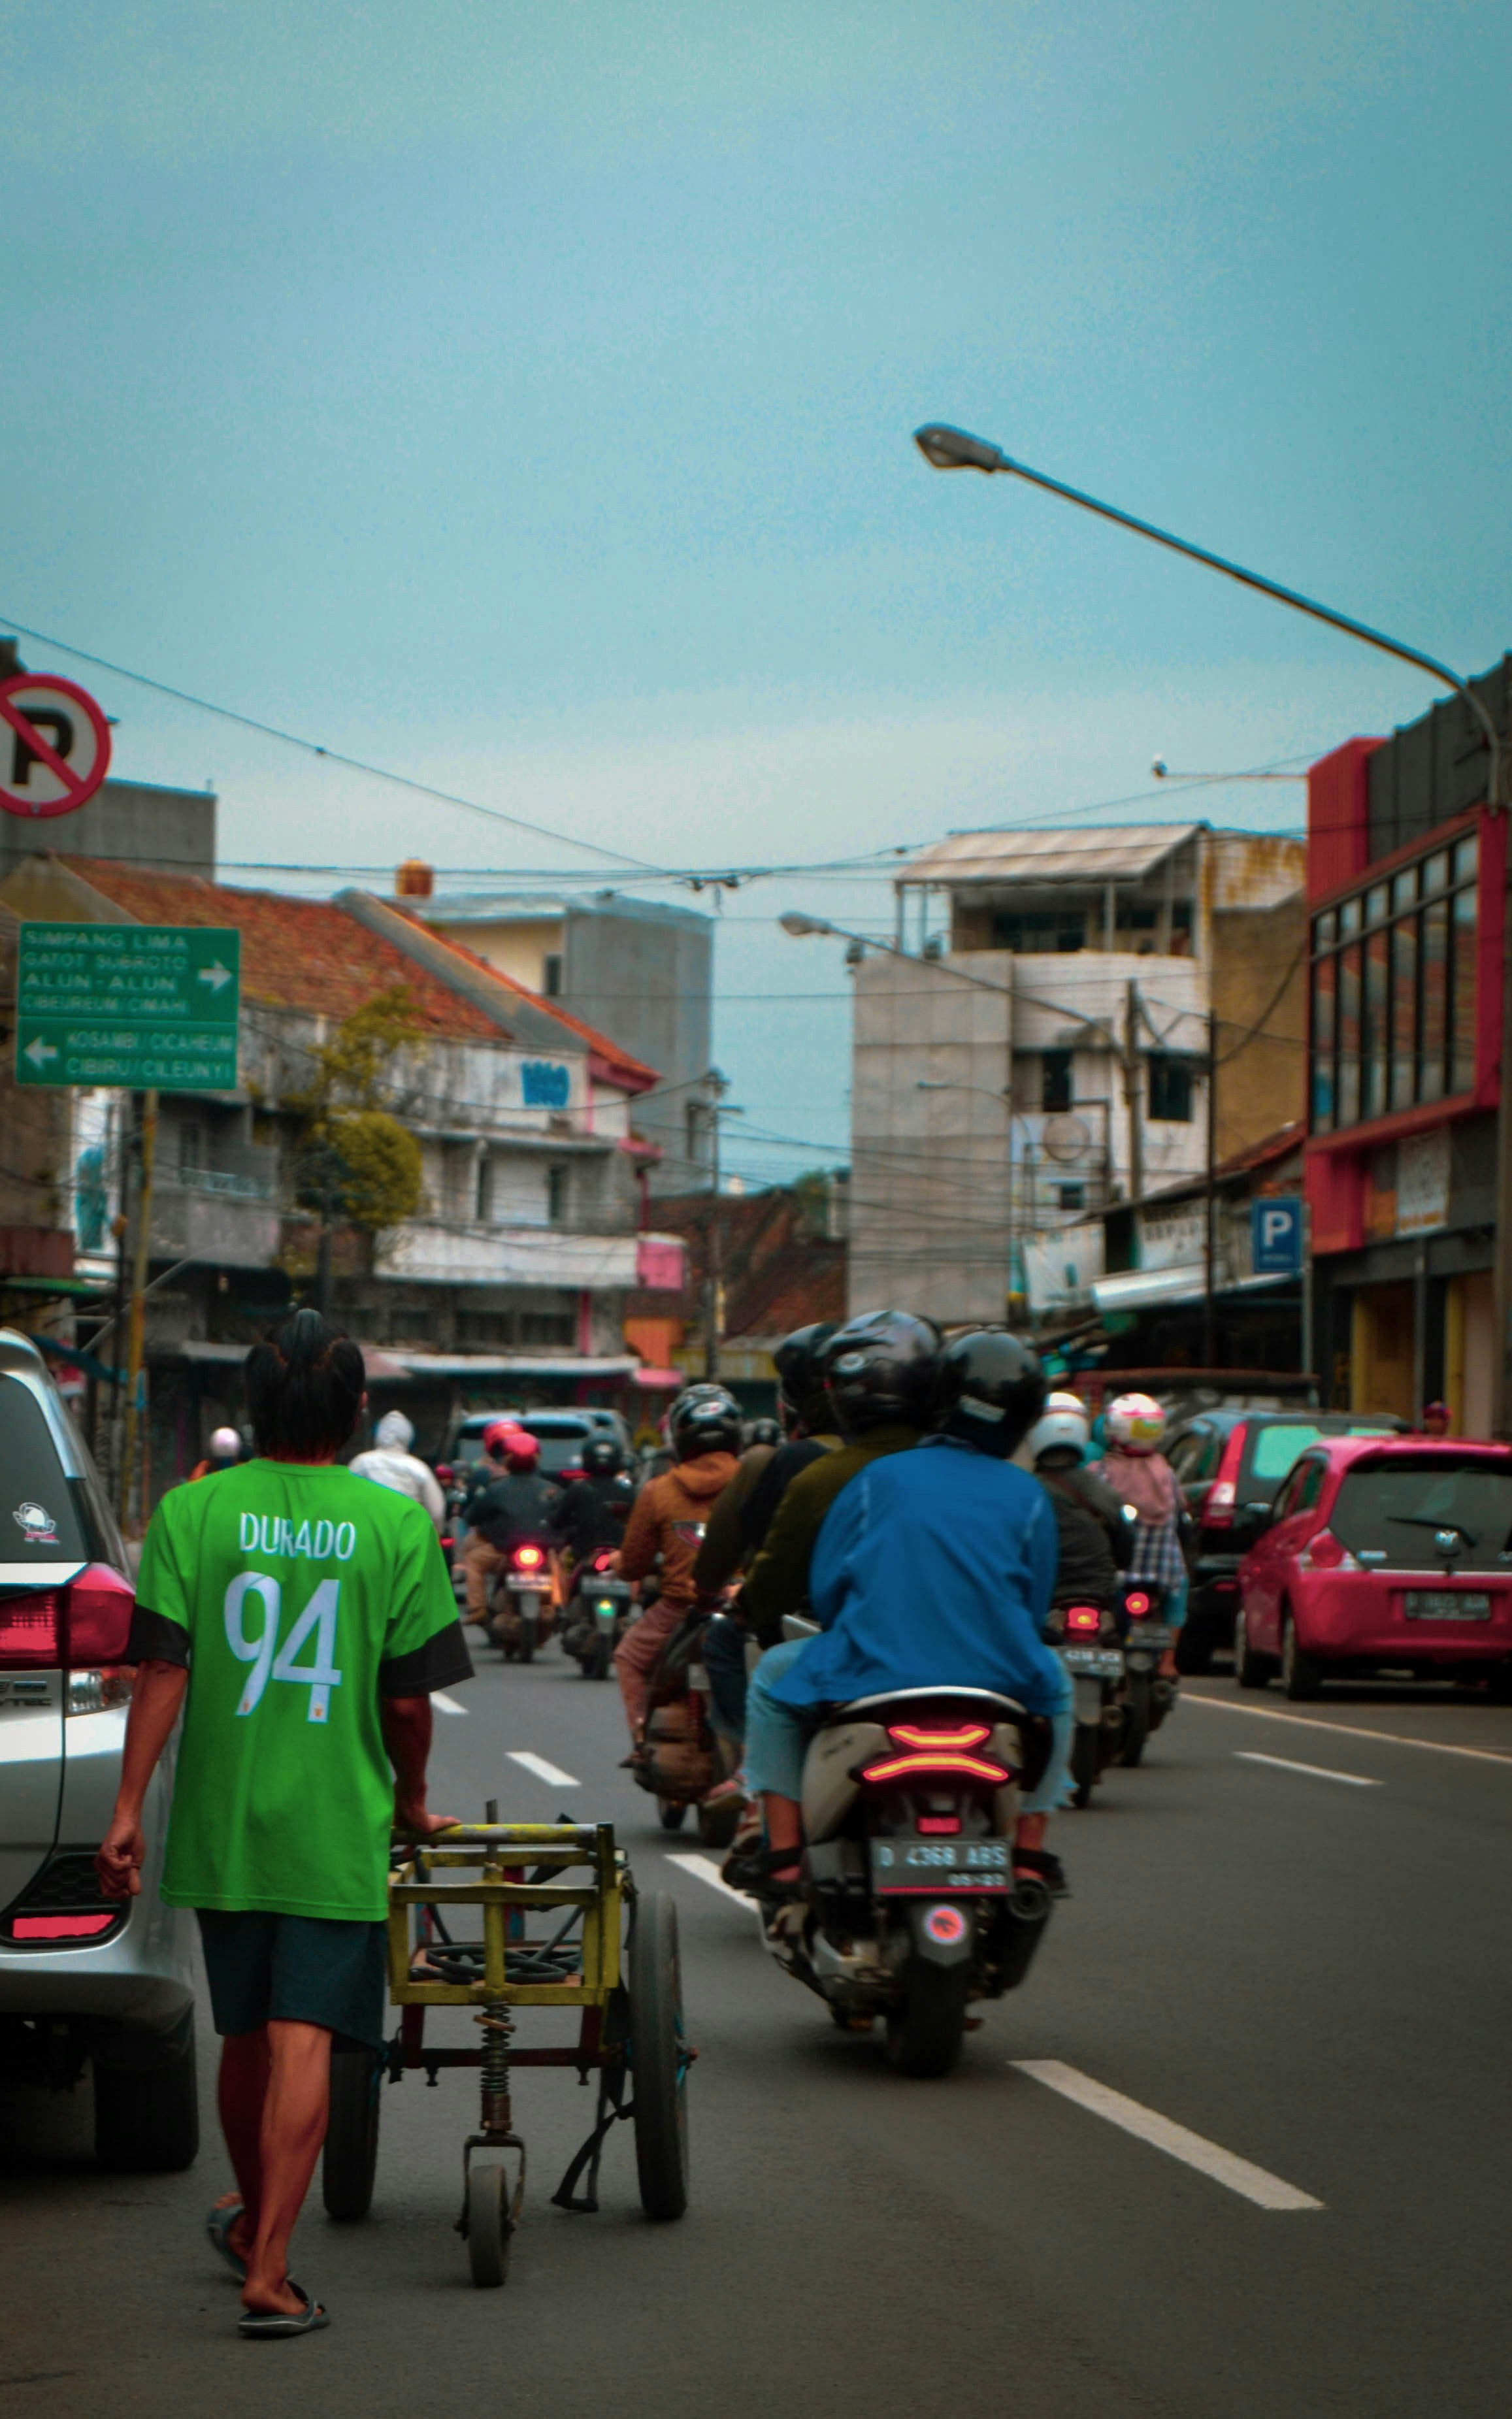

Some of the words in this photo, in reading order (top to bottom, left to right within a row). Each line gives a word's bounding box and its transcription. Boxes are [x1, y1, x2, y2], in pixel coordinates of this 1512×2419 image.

[25, 930, 124, 947] SIMPANG
[133, 934, 188, 948] LIMA
[24, 952, 84, 966] GATOT
[96, 954, 188, 970] SUBROTO
[24, 972, 90, 988] ALUN
[109, 975, 176, 991] ALUN
[1262, 1210, 1292, 1247] P
[239, 1511, 356, 1560] DURADO
[223, 1570, 342, 1724] 94
